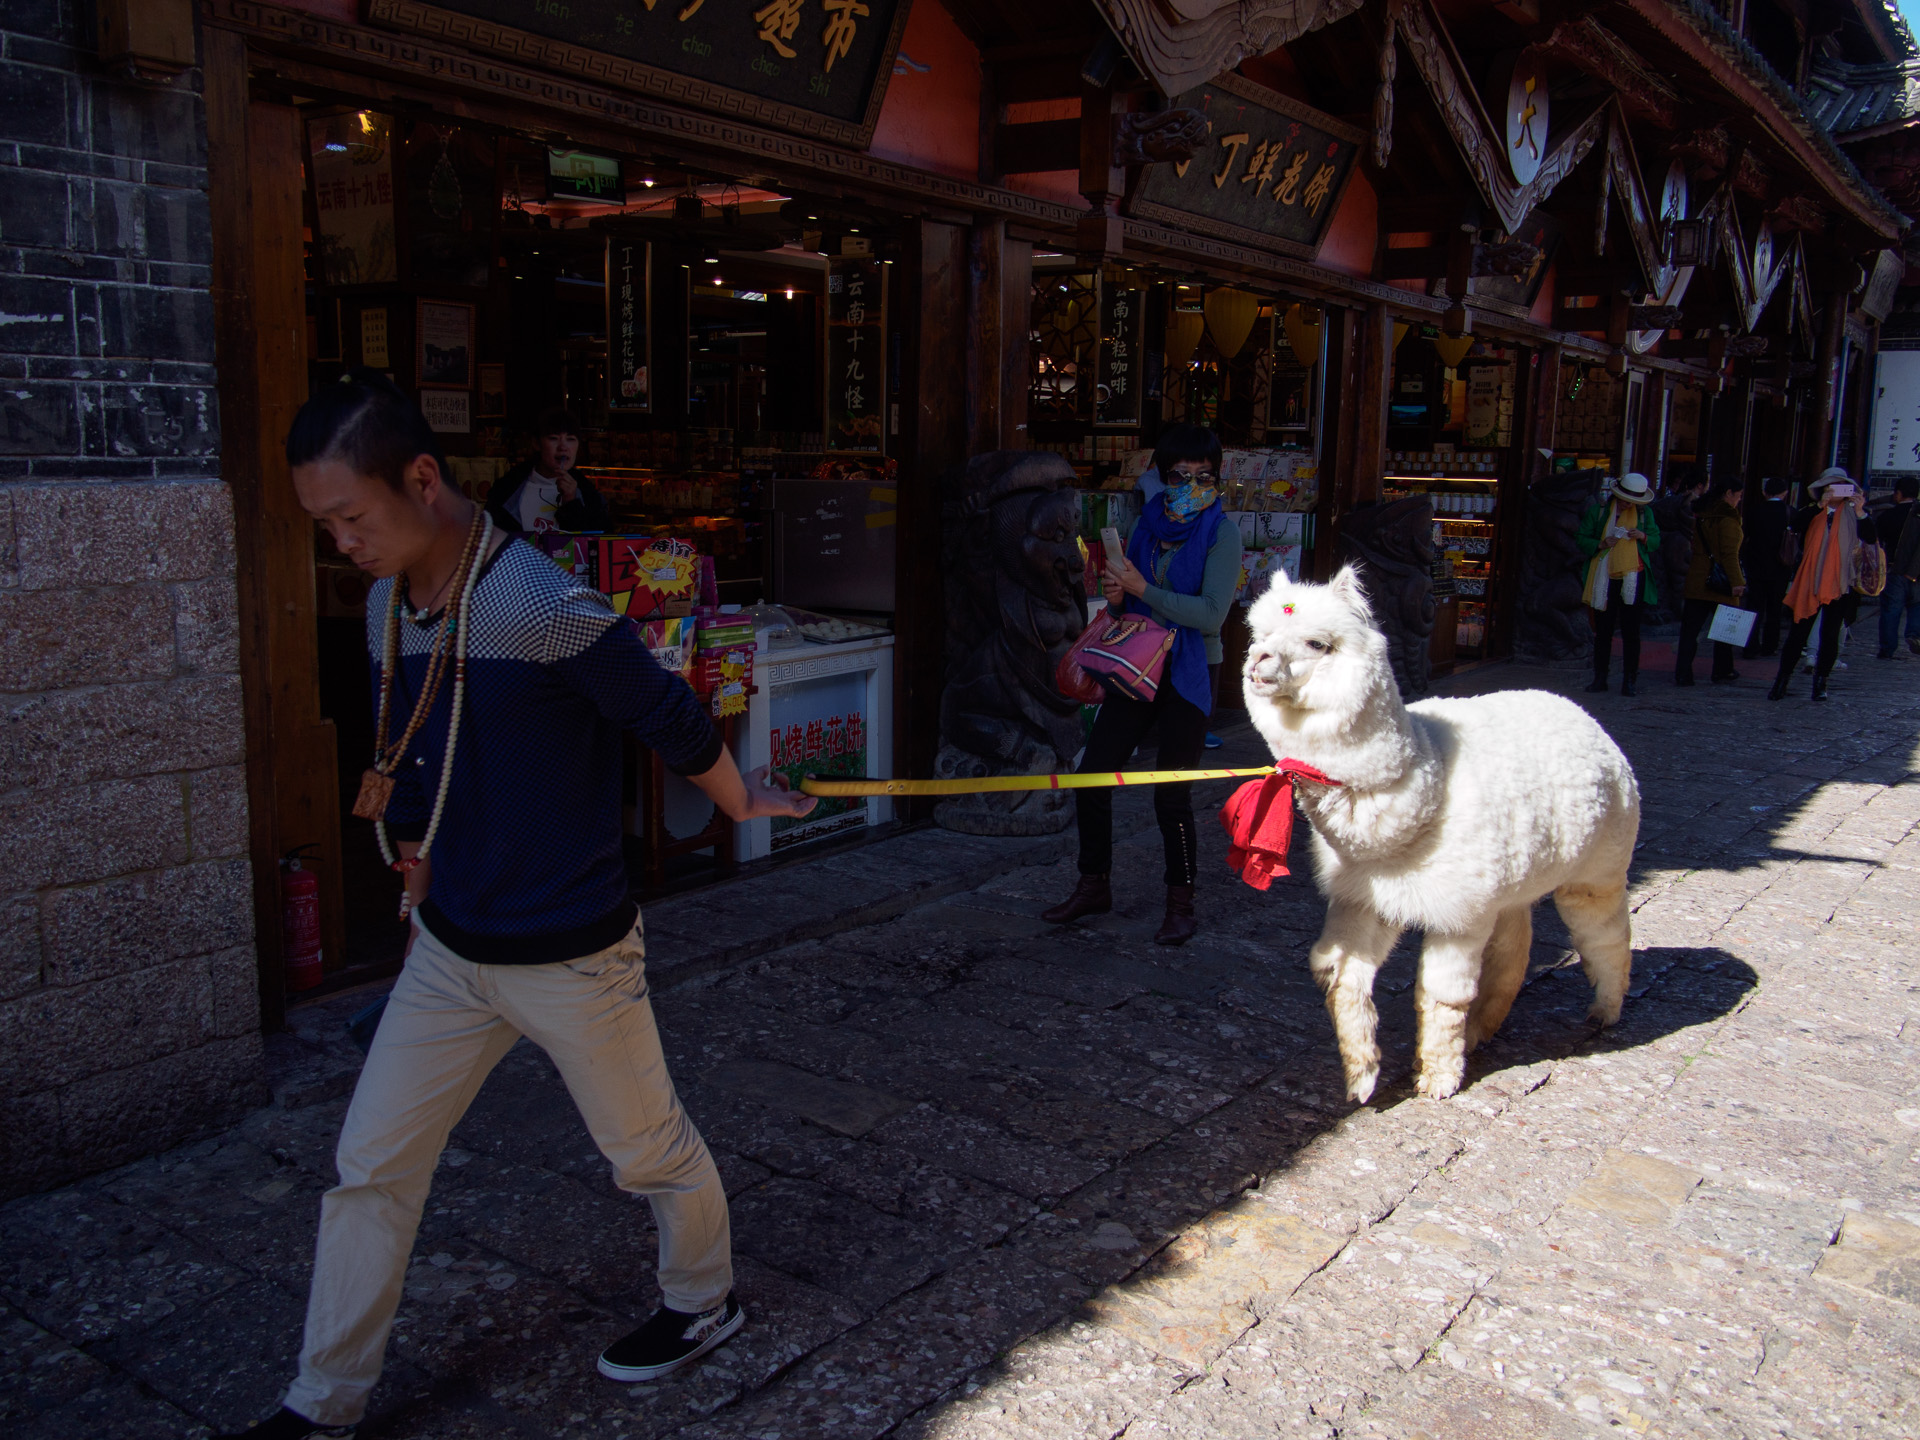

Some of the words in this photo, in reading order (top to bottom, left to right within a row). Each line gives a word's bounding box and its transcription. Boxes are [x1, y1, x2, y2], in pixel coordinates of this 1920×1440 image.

[616, 13, 635, 35] te
[681, 34, 712, 57] chan
[751, 54, 781, 77] chao
[808, 73, 832, 97] shi
[316, 171, 393, 212] 云南十九怪
[1175, 120, 1336, 218] 丁鲜花饼
[845, 272, 866, 411] 云南十九怪
